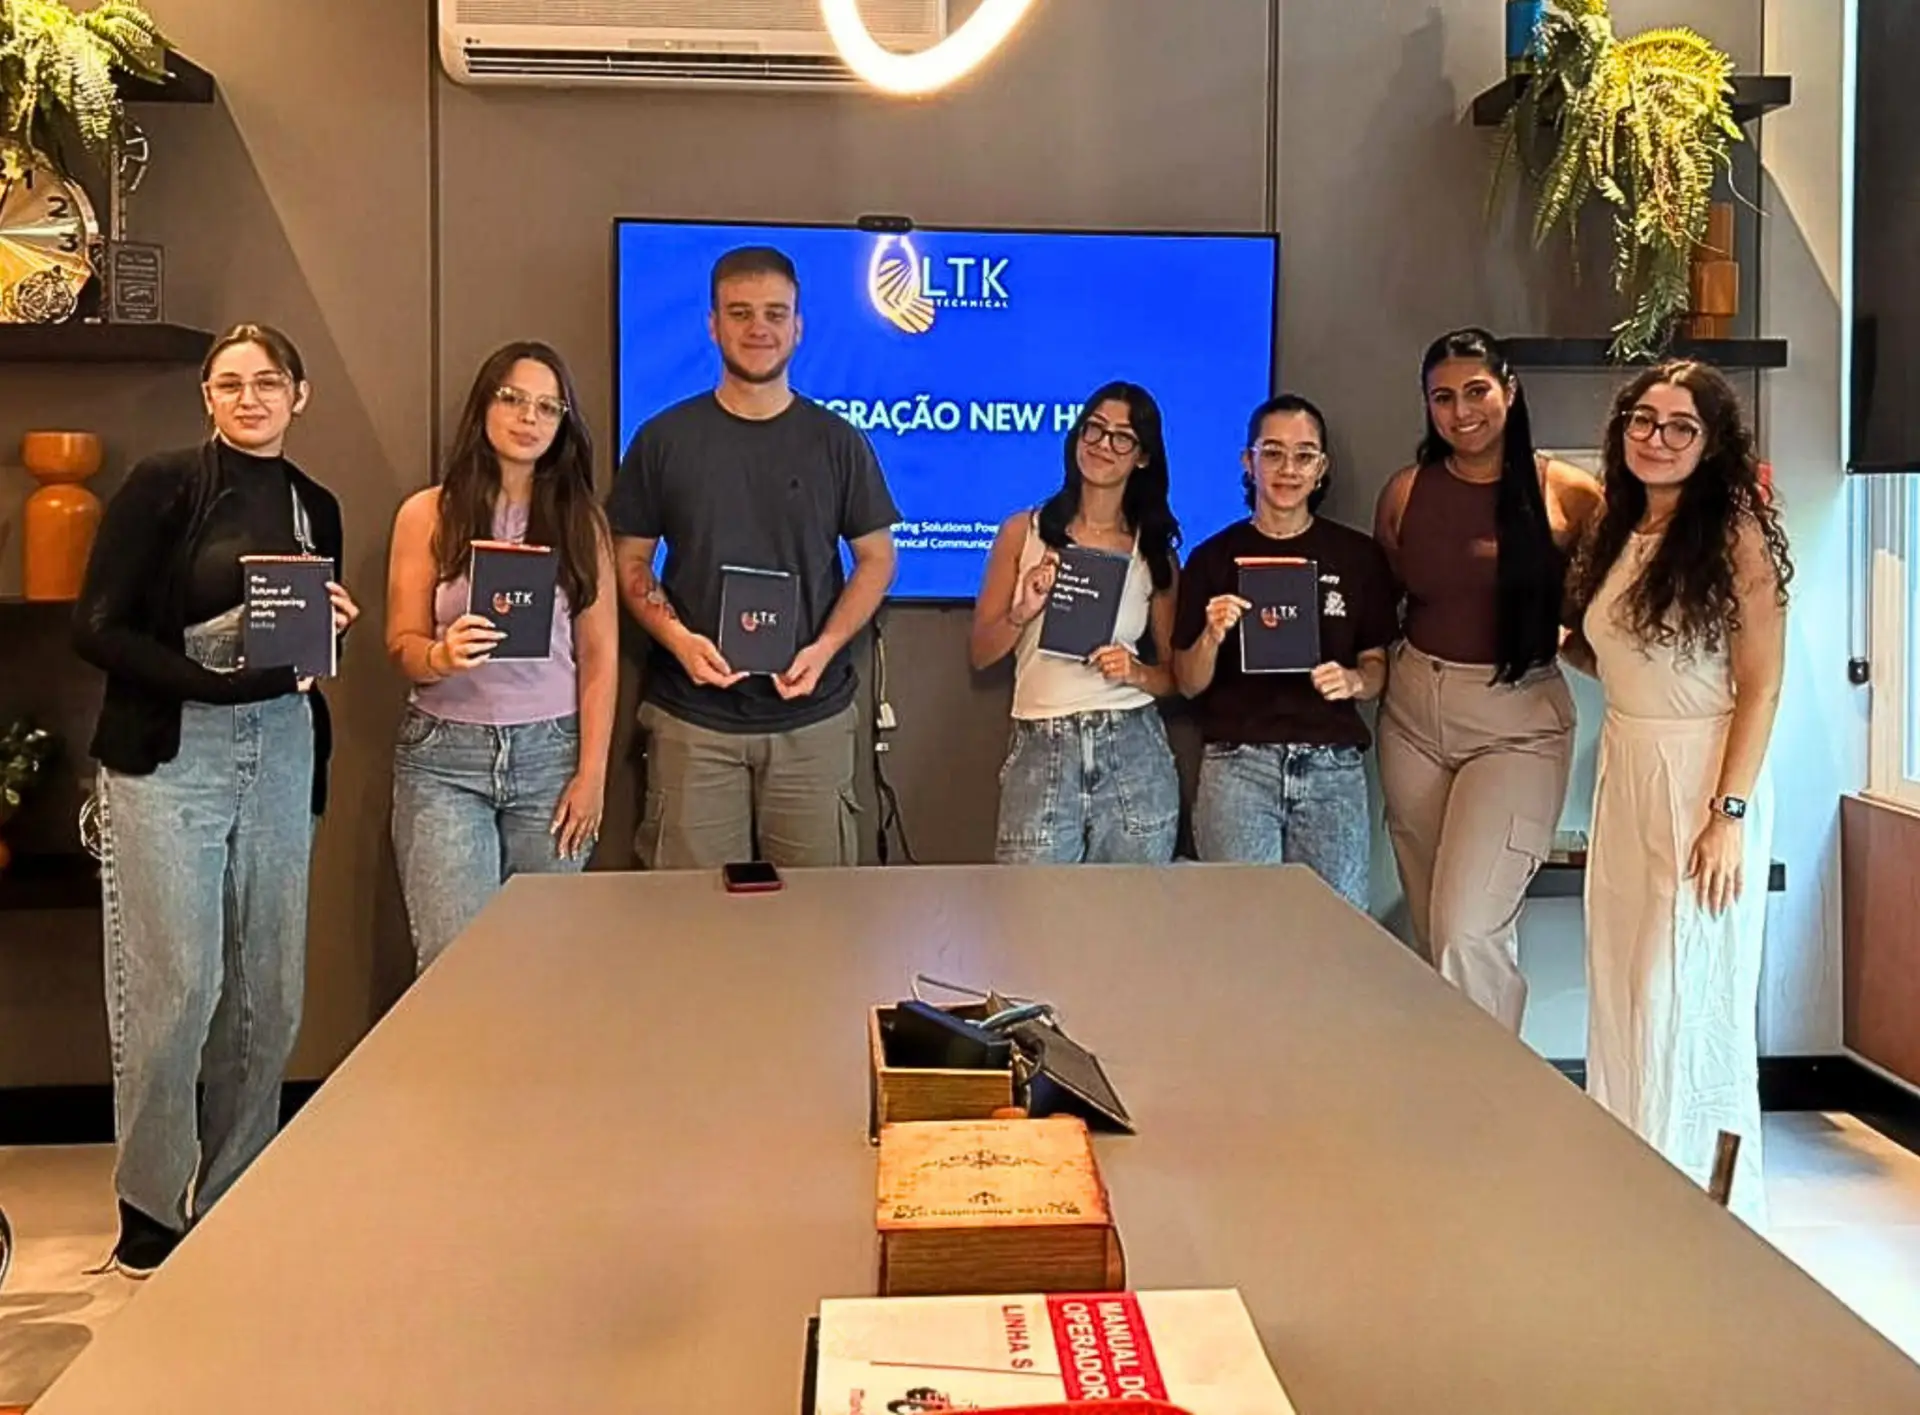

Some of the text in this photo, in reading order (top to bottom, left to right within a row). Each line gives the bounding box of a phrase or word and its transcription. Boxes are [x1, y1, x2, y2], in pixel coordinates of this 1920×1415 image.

[47, 196, 69, 219] 2
[59, 232, 78, 253] 3
[922, 255, 1010, 299] LTK
[936, 298, 1009, 309] TECHNICAL
[812, 394, 961, 436] GRAÇÃO
[968, 401, 1046, 433] NEW
[921, 521, 973, 533] Solutions
[505, 590, 534, 605] LTK
[1000, 1304, 1034, 1370] LINHA S
[1061, 1301, 1111, 1401] OPERADOR
[1097, 1301, 1140, 1374] MANUAL
